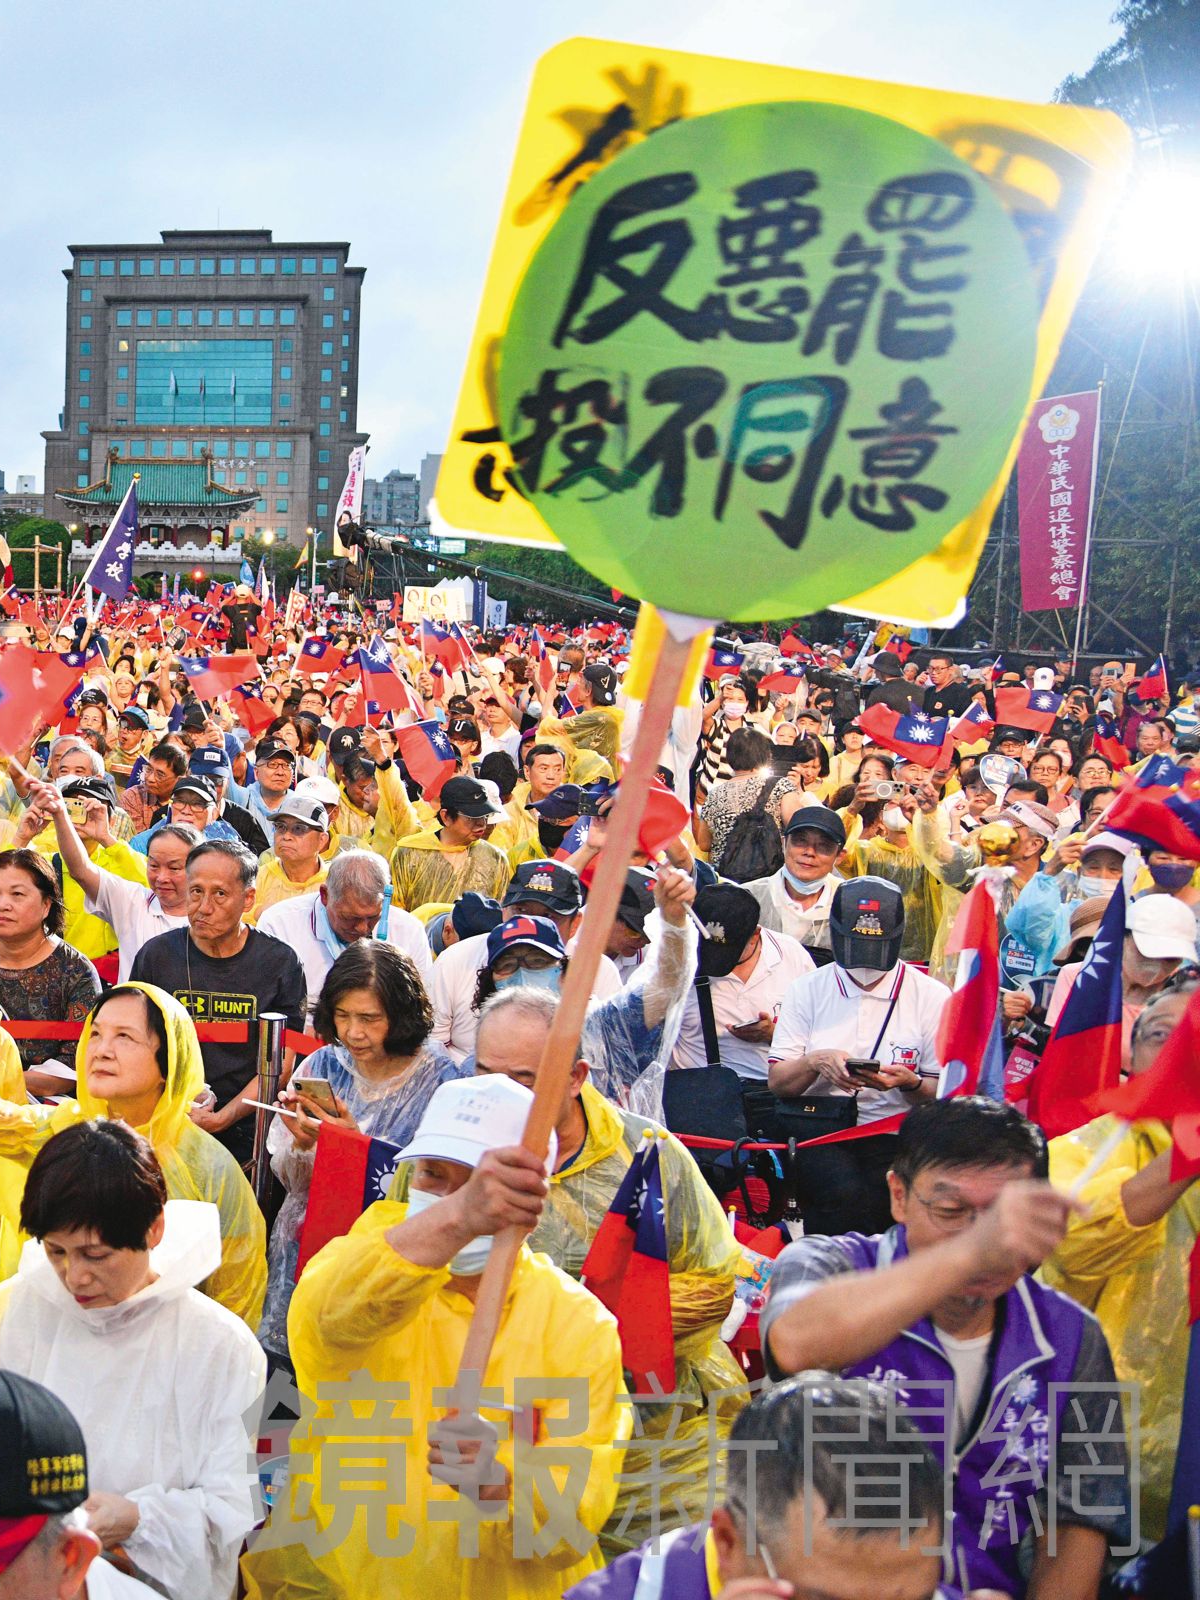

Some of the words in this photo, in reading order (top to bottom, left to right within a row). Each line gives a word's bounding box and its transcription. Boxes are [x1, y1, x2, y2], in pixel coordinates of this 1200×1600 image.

[511, 366, 959, 550] 投不同意
[1048, 445, 1078, 601] 中華民國退休警察總會
[214, 1001, 251, 1015] HUNT
